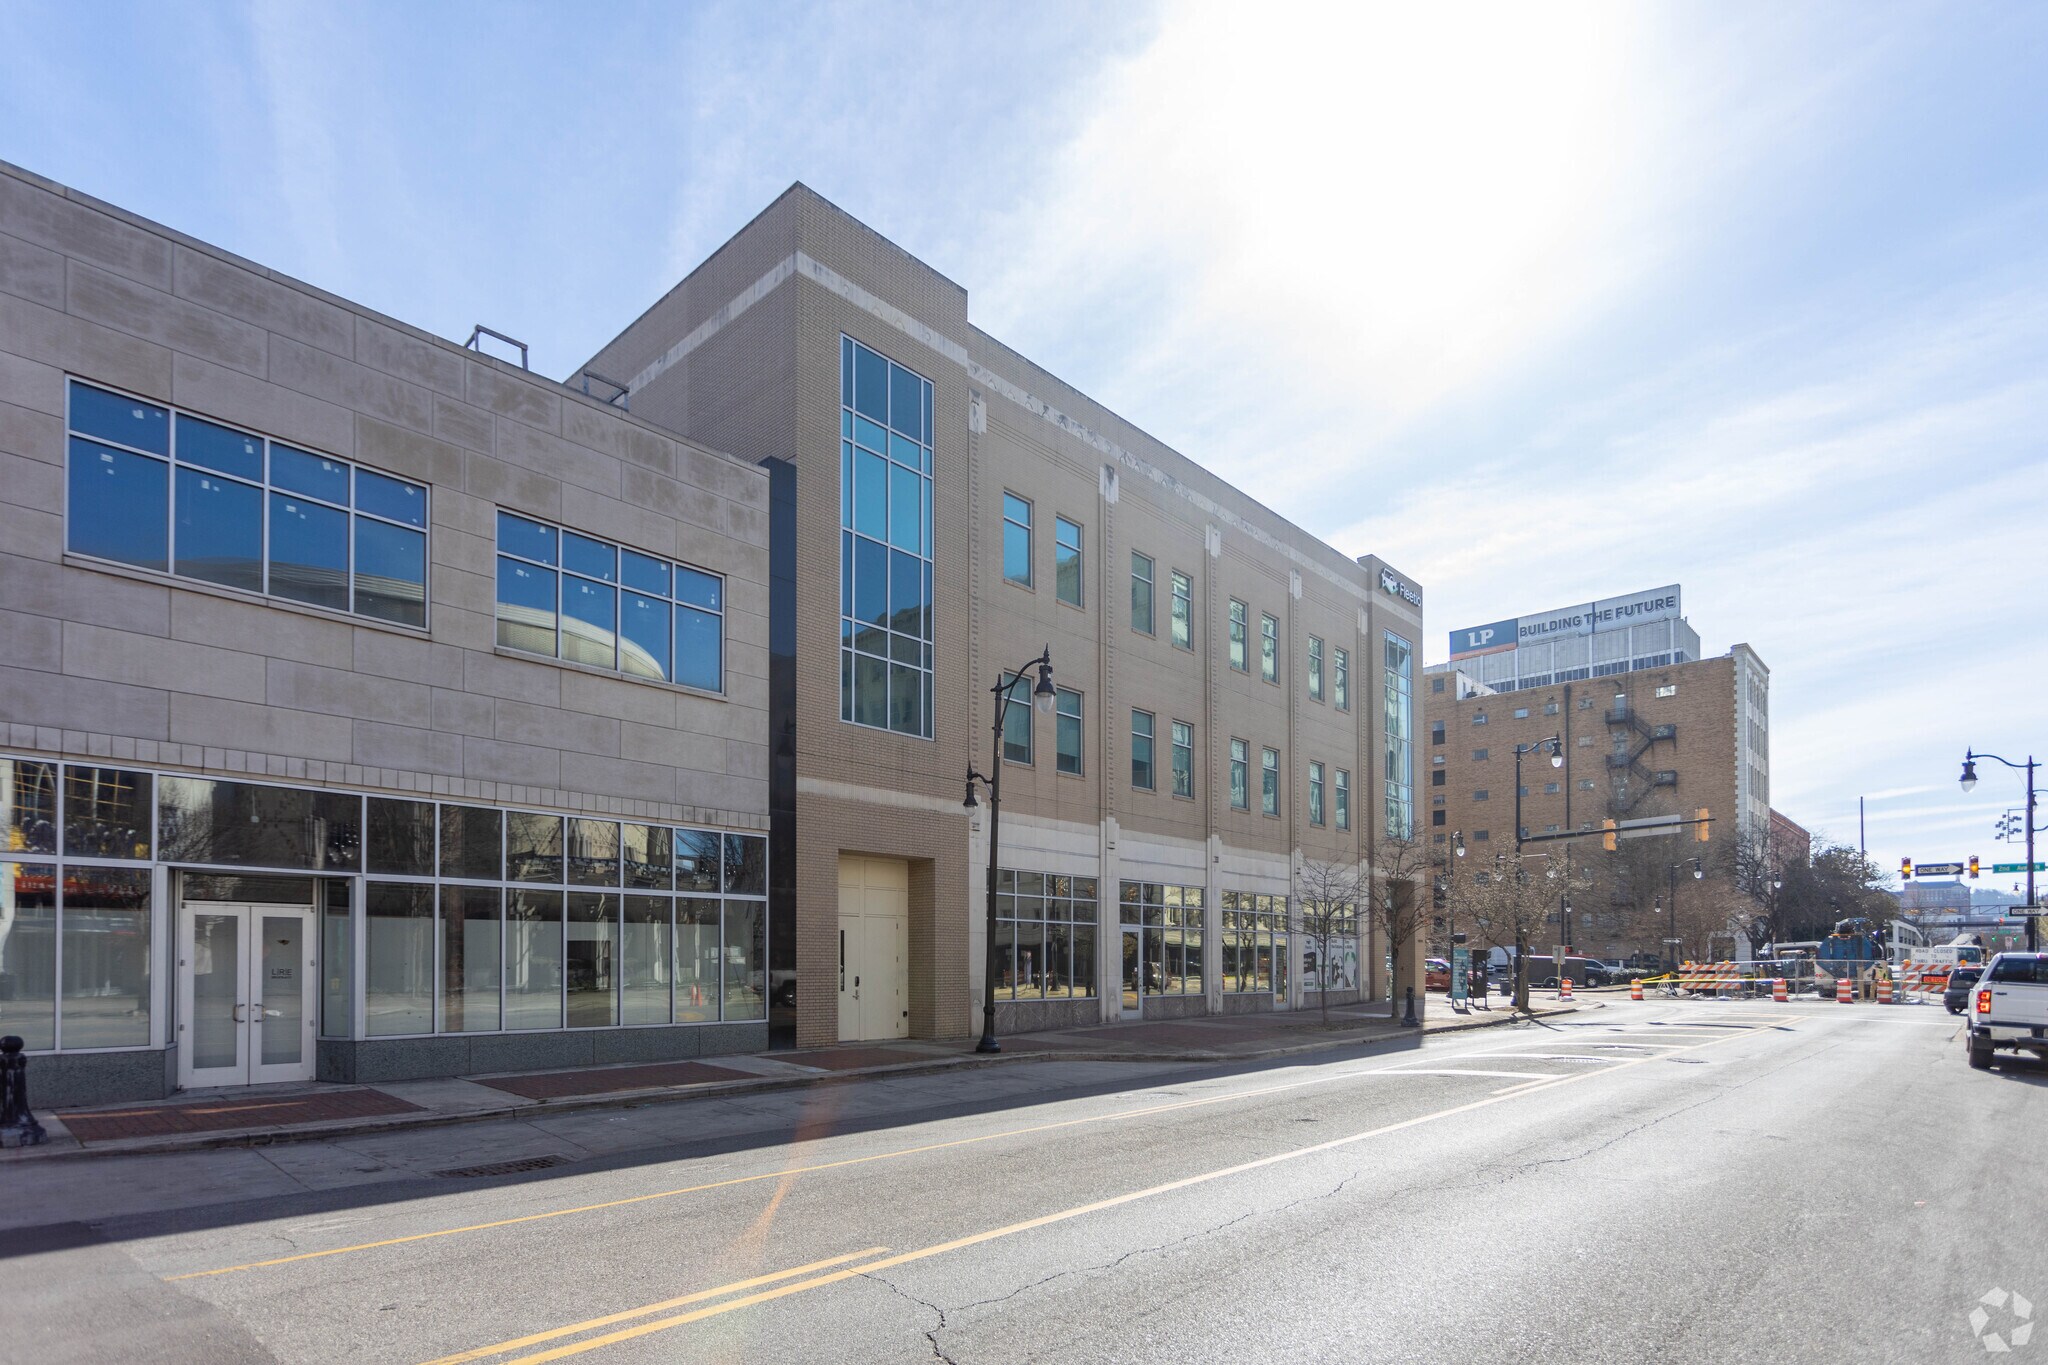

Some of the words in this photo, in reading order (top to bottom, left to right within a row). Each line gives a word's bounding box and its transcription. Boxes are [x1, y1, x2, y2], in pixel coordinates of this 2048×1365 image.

[1399, 582, 1422, 607] Fleetio
[1519, 615, 1583, 638] BUILDING
[1584, 608, 1613, 626] THE
[1615, 595, 1677, 619] FUTURE
[1468, 628, 1494, 648] LP
